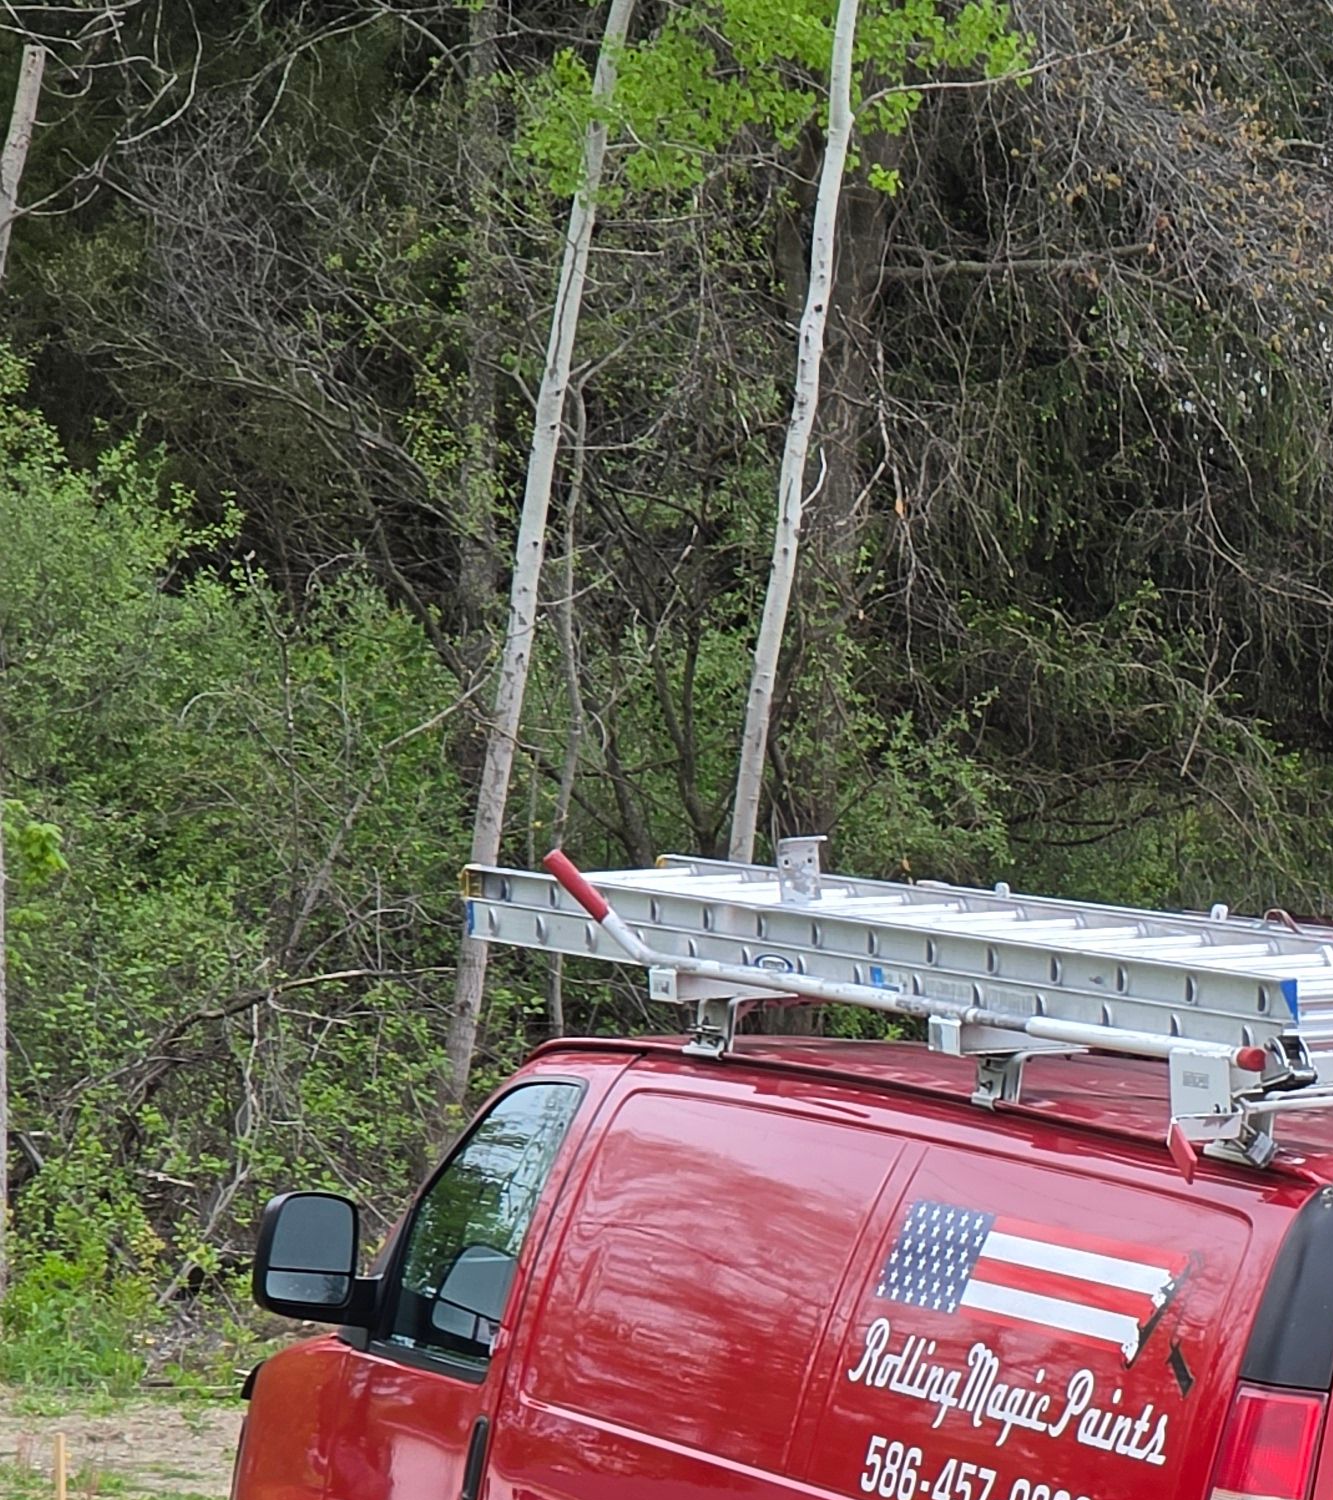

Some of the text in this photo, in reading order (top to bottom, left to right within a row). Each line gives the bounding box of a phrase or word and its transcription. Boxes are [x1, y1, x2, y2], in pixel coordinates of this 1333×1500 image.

[848, 1318, 1169, 1466] Rolling Magic Paints
